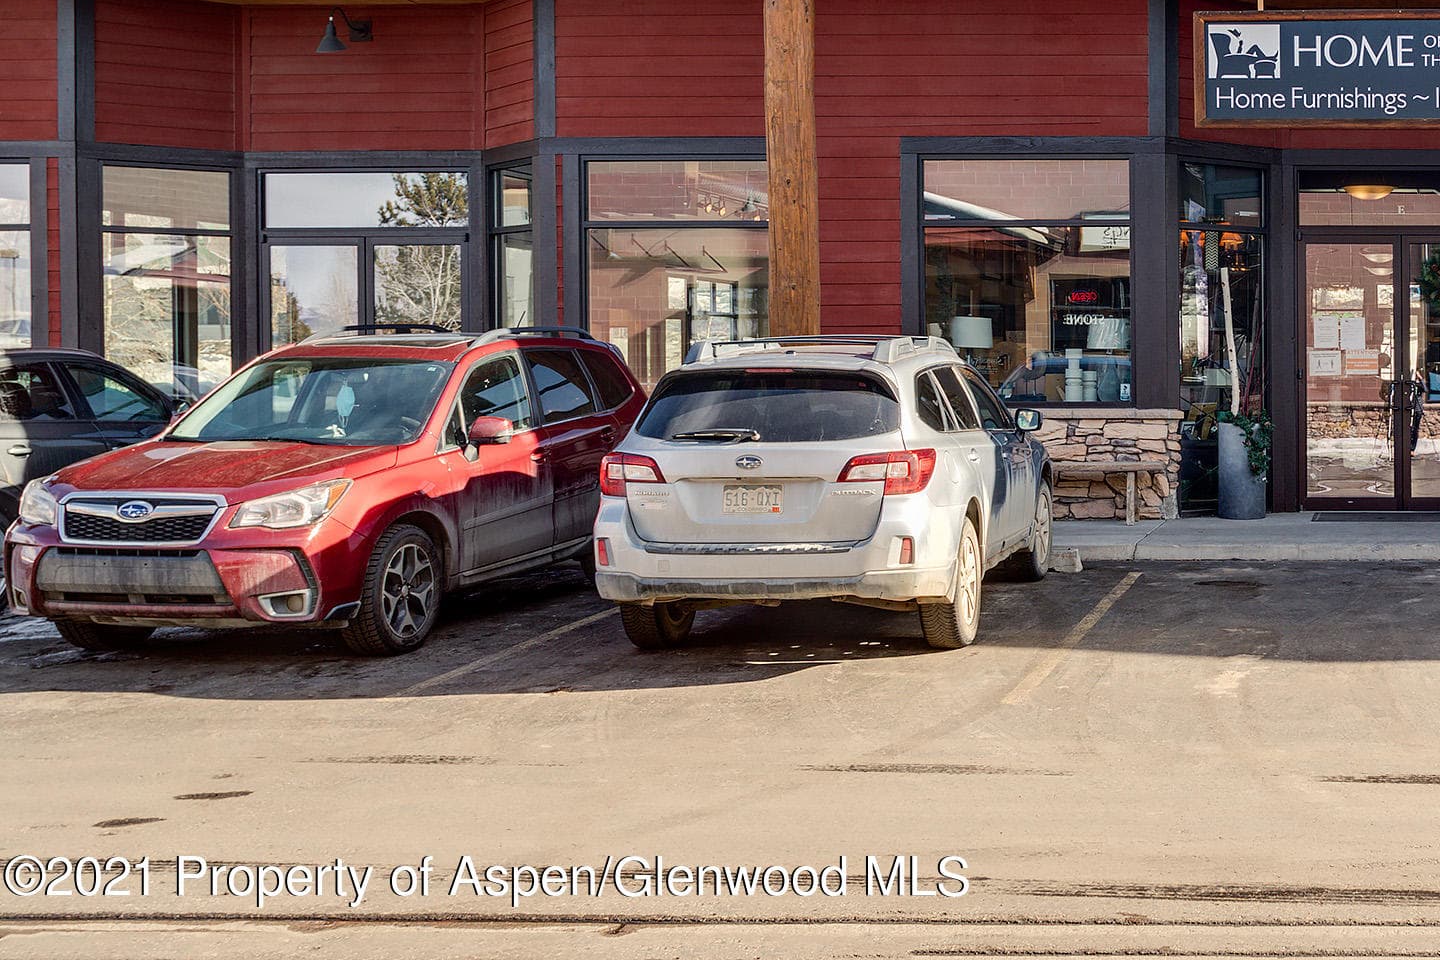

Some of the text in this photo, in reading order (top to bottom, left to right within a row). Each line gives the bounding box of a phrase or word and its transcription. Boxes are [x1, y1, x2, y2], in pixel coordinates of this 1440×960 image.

[1293, 34, 1415, 68] HOME
[1215, 86, 1286, 109] Home
[1291, 86, 1407, 115] Furnishings
[1397, 205, 1406, 215] E
